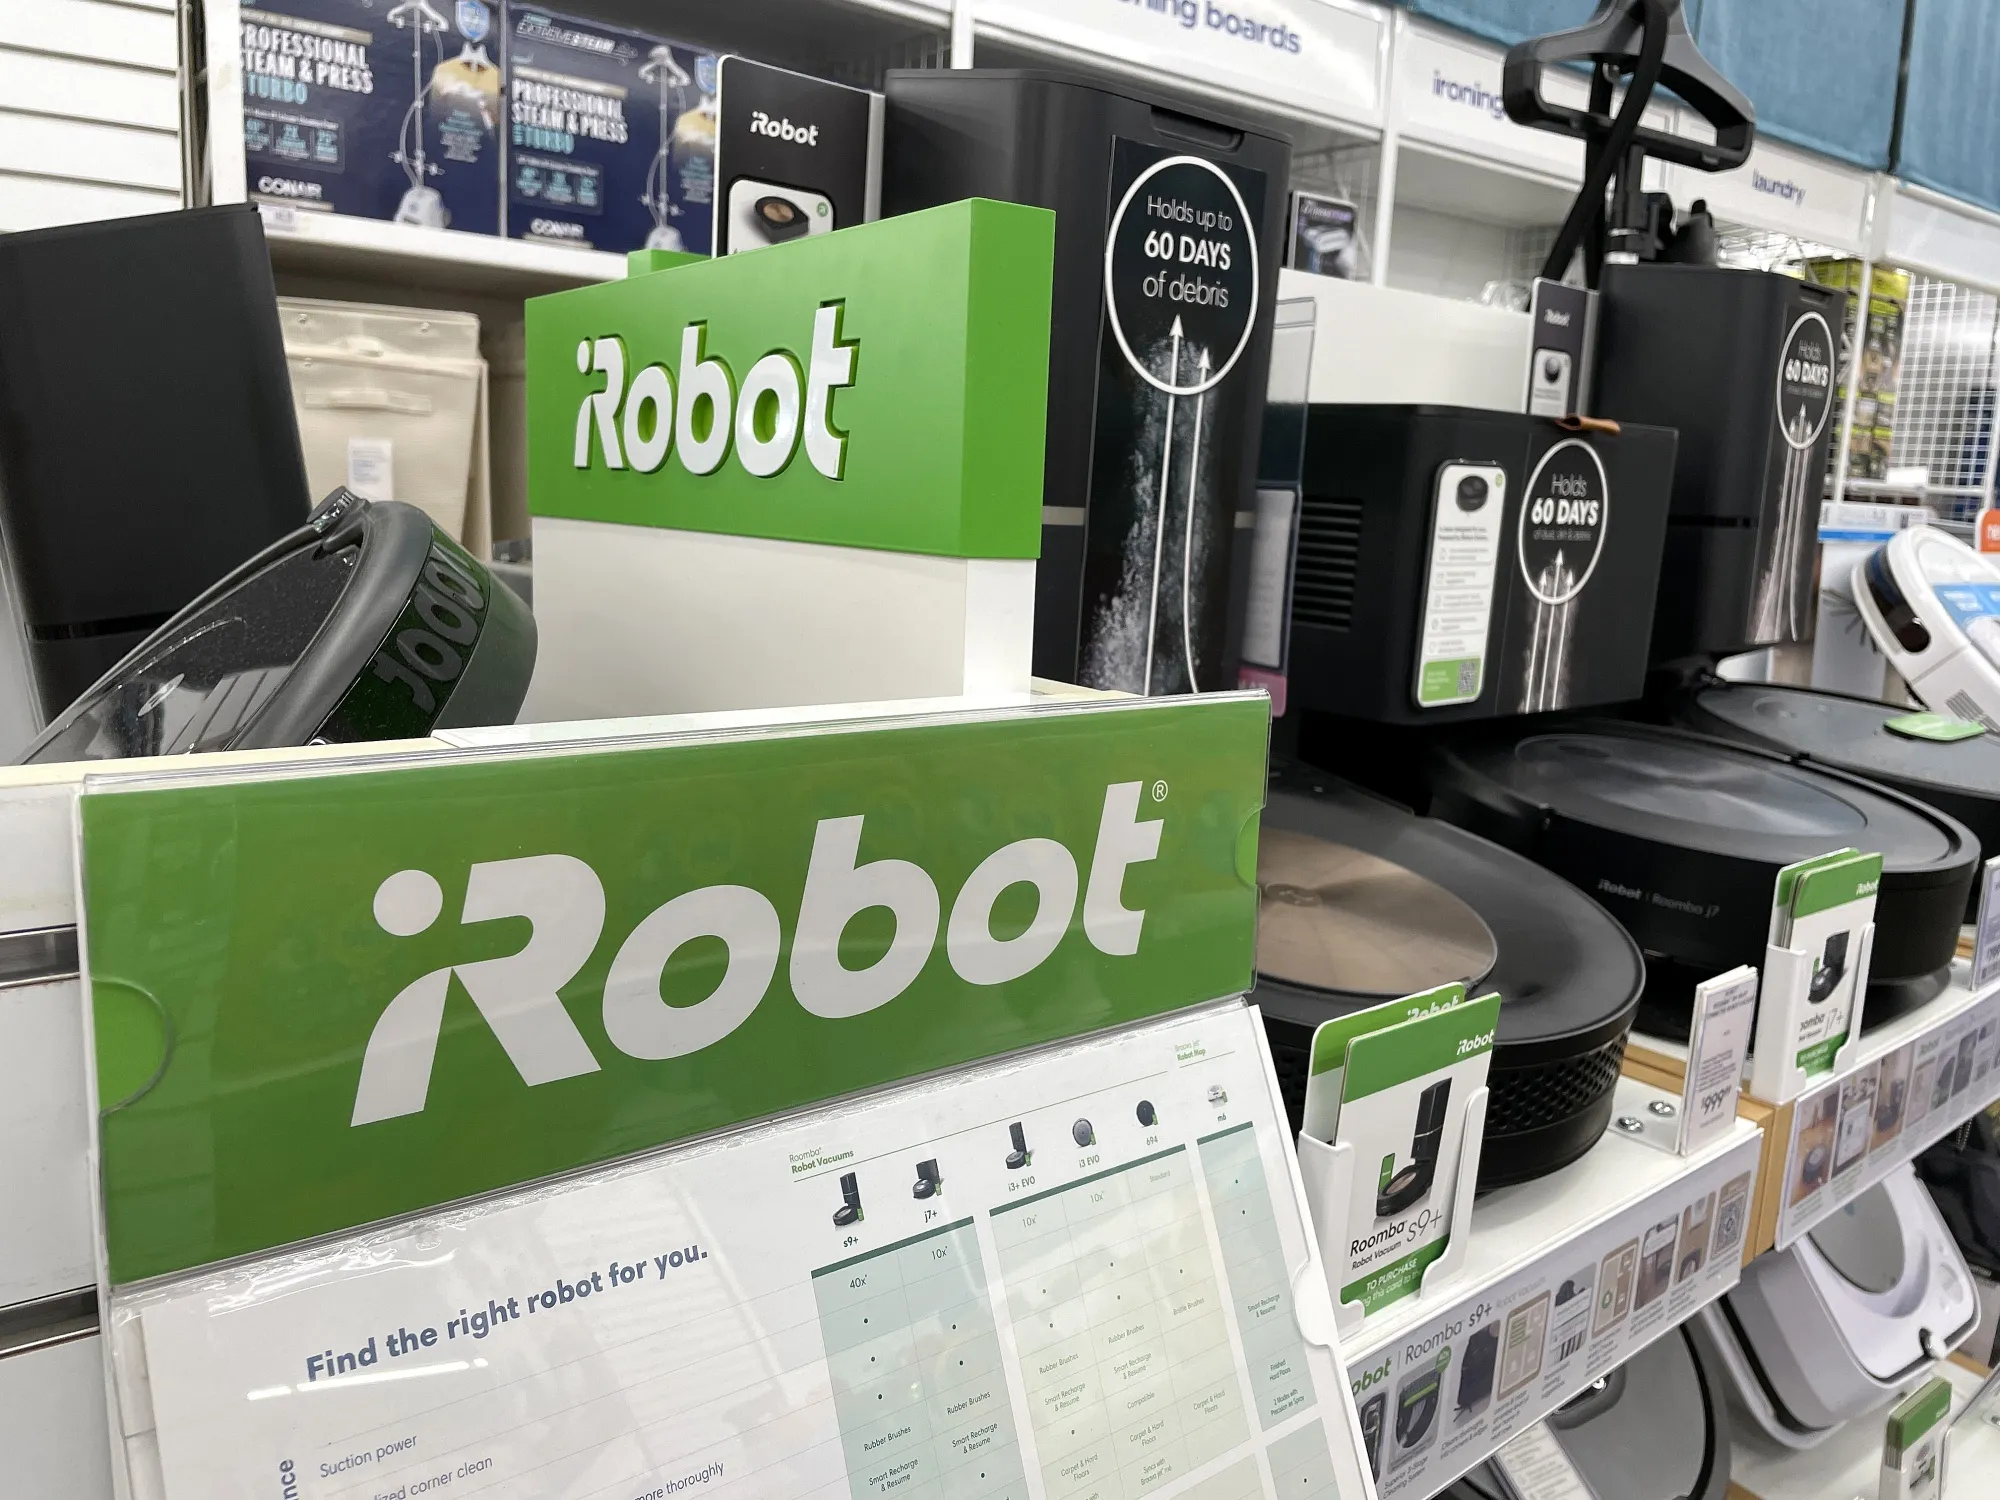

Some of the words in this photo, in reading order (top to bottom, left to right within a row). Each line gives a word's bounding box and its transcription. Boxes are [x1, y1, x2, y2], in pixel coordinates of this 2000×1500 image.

[1206, 1, 1302, 53] boards
[298, 58, 314, 83] &
[316, 61, 374, 94] PRESS
[1434, 69, 1504, 119] ironing
[750, 110, 819, 147] iRobot
[1752, 168, 1806, 207] laundry
[1147, 195, 1194, 224] Holds
[1196, 210, 1217, 232] up
[1217, 211, 1233, 232] to
[1144, 230, 1174, 260] 60
[1179, 236, 1231, 271] DAYS
[1142, 270, 1168, 299] of
[1168, 271, 1229, 308] debris
[1785, 358, 1801, 382] 60
[1801, 361, 1829, 387] DAYS
[574, 303, 857, 481] iRobot
[1551, 472, 1587, 498] Holds
[1531, 497, 1555, 525] 60
[1556, 499, 1599, 527] DAYS
[1652, 893, 1704, 915] Roomba
[1456, 1028, 1495, 1056] iRobot
[1217, 1113, 1227, 1122] m6
[1146, 1135, 1159, 1146] 694
[791, 1160, 817, 1174] Robot
[816, 1150, 854, 1166] Vacuums
[1079, 1158, 1086, 1169] i3
[1086, 1154, 1100, 1166] EVO
[1007, 1180, 1020, 1193] i3+
[1021, 1175, 1036, 1188] EVO
[923, 1209, 938, 1223] j7+
[843, 1235, 859, 1248] s9+
[1350, 1221, 1406, 1257] Roomba
[1406, 1208, 1443, 1243] s9+
[1351, 1253, 1373, 1270] Robot
[1374, 1241, 1402, 1259] Vacuum
[1366, 1279, 1377, 1292] TO
[1378, 1258, 1418, 1285] PURCHASE
[306, 1337, 378, 1382] Find
[386, 1327, 439, 1357] the
[447, 1296, 520, 1340] right
[527, 1271, 604, 1314] robot
[608, 1260, 647, 1288] for
[654, 1244, 708, 1280] you.
[1108, 1332, 1126, 1344] Rubber
[1126, 1323, 1145, 1337] Brushes
[1405, 1320, 1463, 1365] Roomba
[1469, 1303, 1493, 1328] s9+
[1039, 1362, 1058, 1375] Rubber
[1058, 1352, 1079, 1366] Brushes
[1113, 1362, 1129, 1374] Smart
[1129, 1352, 1152, 1367] Recharge
[947, 1401, 968, 1415] Rubber
[968, 1391, 991, 1406] Brushes
[1044, 1394, 1061, 1406] Smart
[1061, 1382, 1086, 1399] Recharge
[1059, 1395, 1080, 1409] Resume
[1127, 1391, 1155, 1409] Compatible
[863, 1436, 887, 1452] Rubber
[887, 1426, 912, 1441] Brushes
[952, 1434, 971, 1448] Smart
[970, 1422, 998, 1440] Recharge
[963, 1446, 968, 1454] &
[968, 1436, 991, 1451] Resume
[1129, 1429, 1147, 1442] Carpet
[1141, 1435, 1157, 1447] Floors
[319, 1450, 373, 1479] Suction
[376, 1434, 418, 1462] power
[1060, 1463, 1080, 1477] Carpet
[1080, 1460, 1085, 1468] &
[1084, 1453, 1099, 1465] Hard
[279, 1458, 298, 1500] nce
[410, 1470, 453, 1496] corner
[457, 1456, 494, 1479] clean
[666, 1461, 724, 1494] thoroughly
[868, 1471, 888, 1486] Smart
[889, 1458, 919, 1477] Recharge
[880, 1483, 886, 1493] &
[886, 1473, 911, 1490] Resume
[1073, 1468, 1090, 1481] Floors
